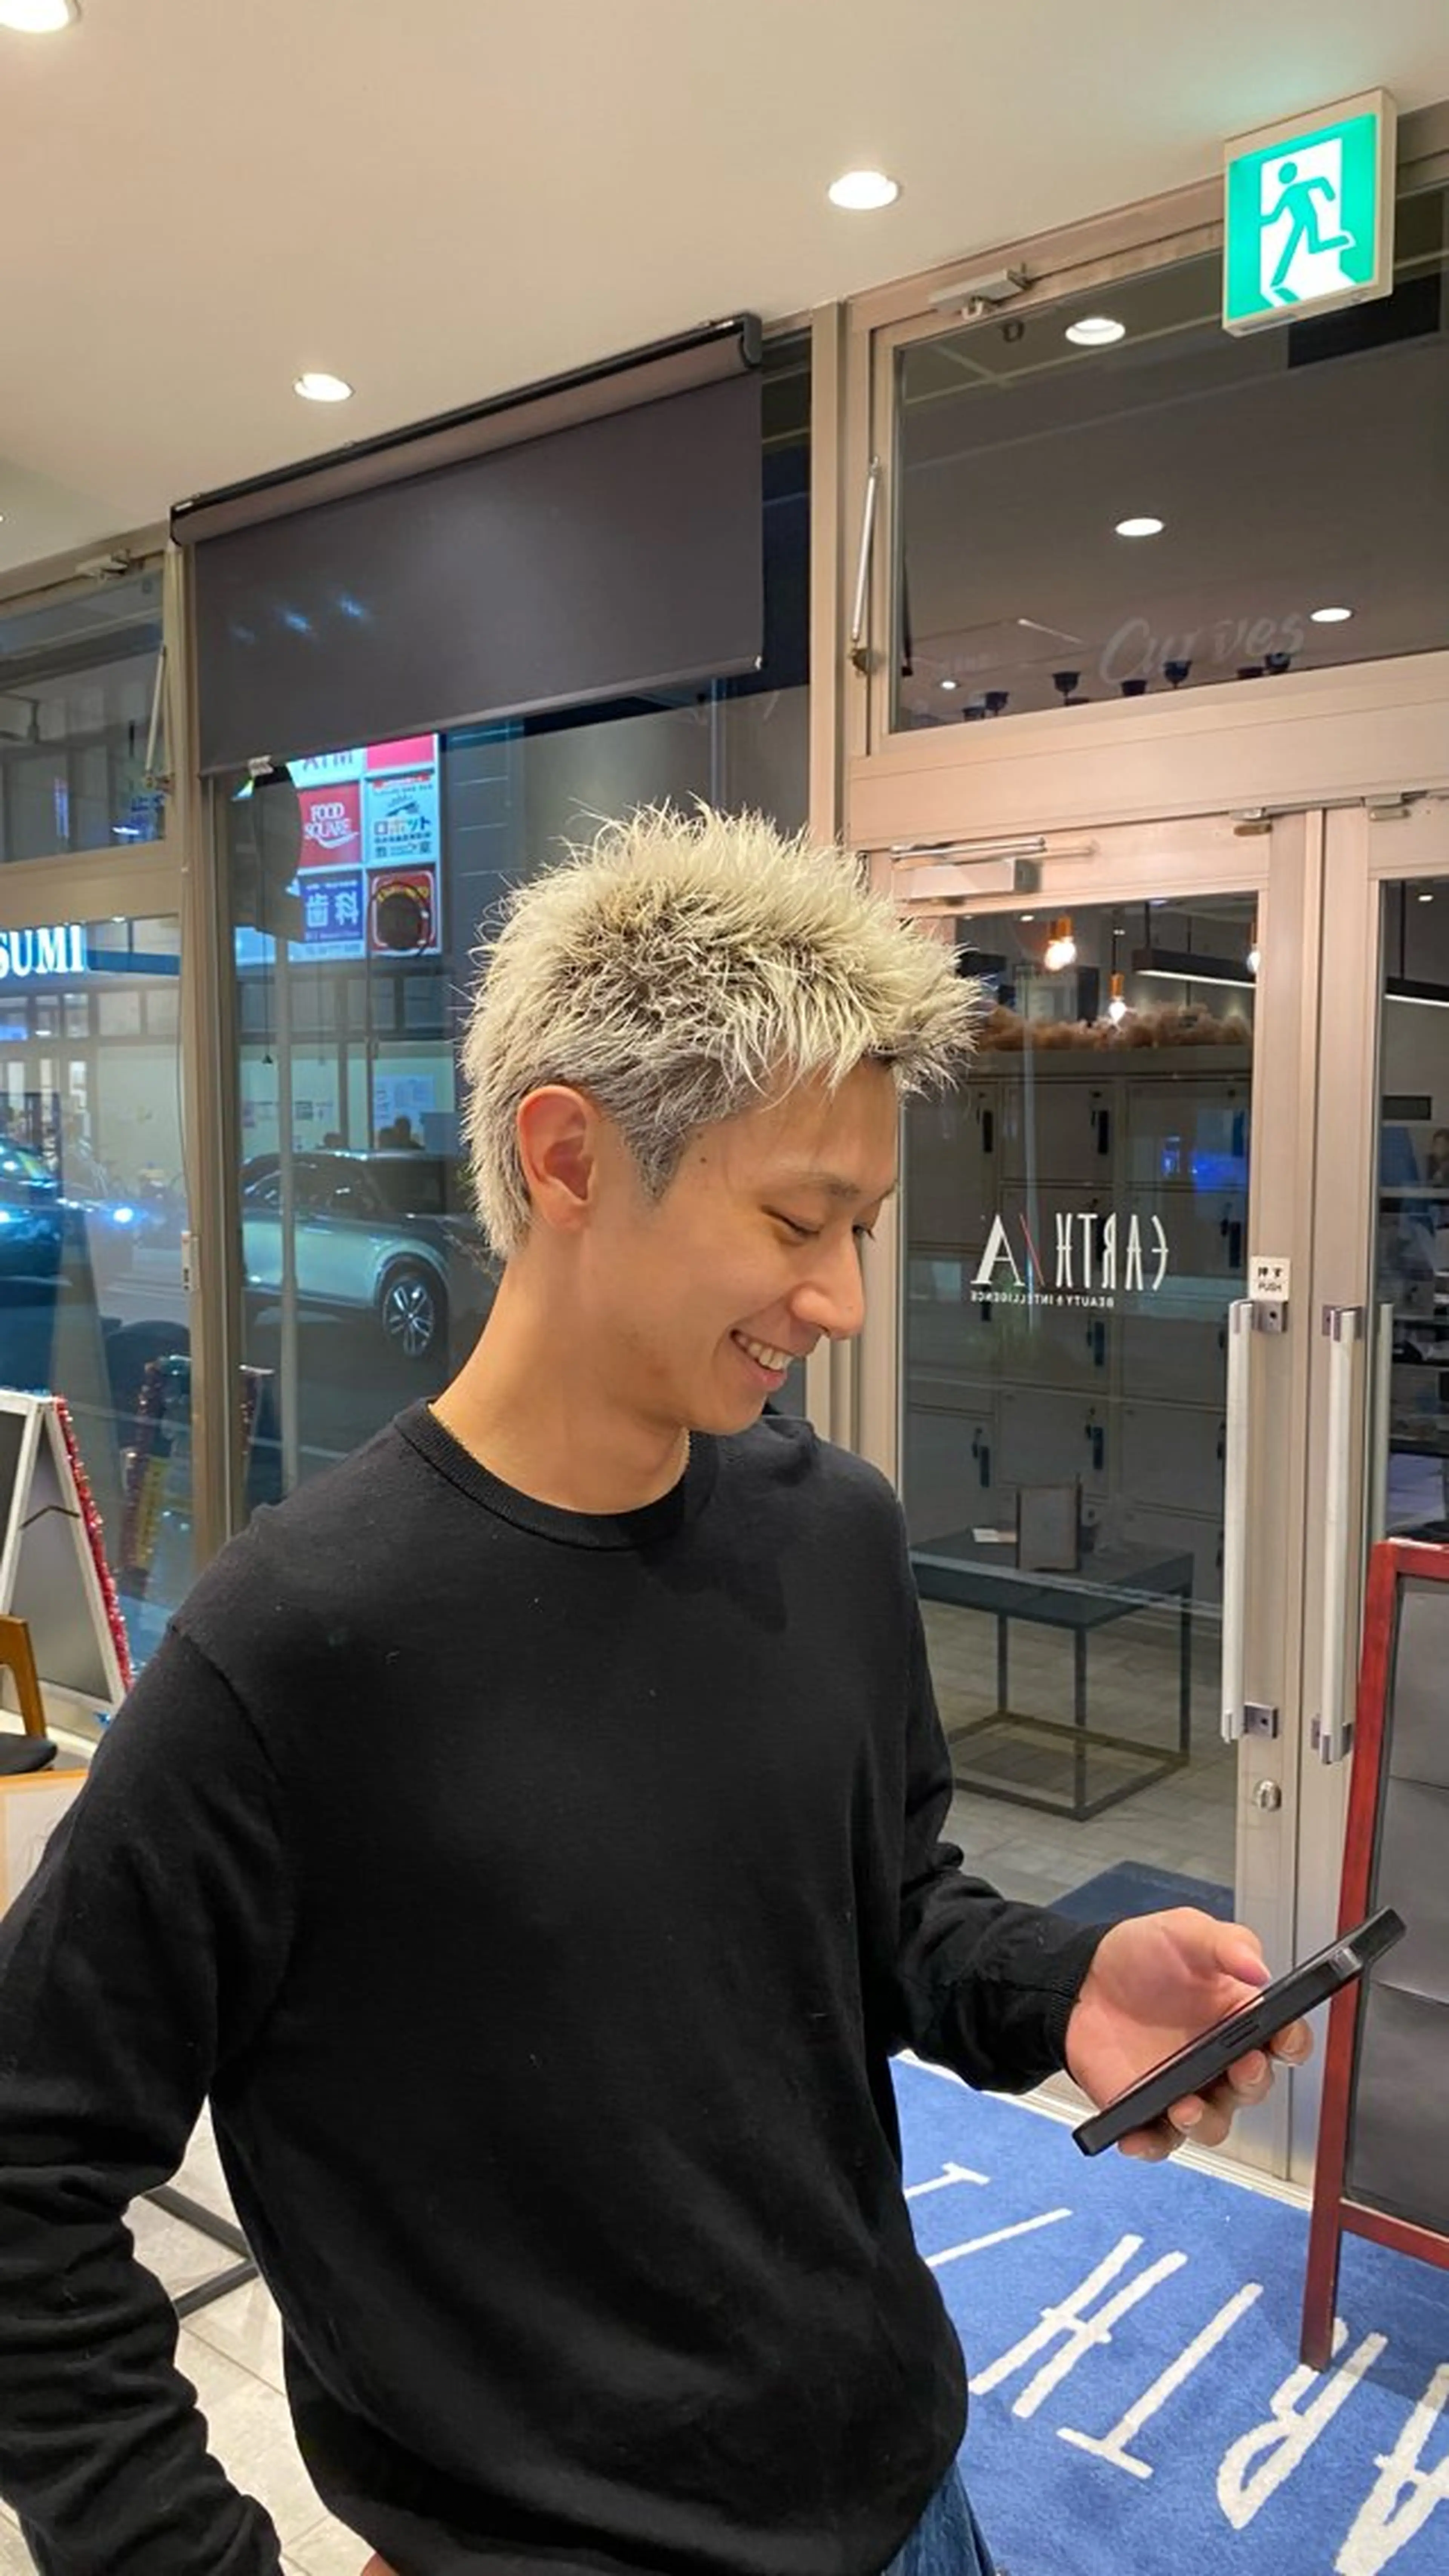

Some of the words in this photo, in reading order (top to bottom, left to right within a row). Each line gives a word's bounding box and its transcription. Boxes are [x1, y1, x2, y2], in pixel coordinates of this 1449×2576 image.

[310, 802, 346, 822] FOOD
[306, 890, 359, 929] 歯科
[1258, 1282, 1282, 1292] PUSH
